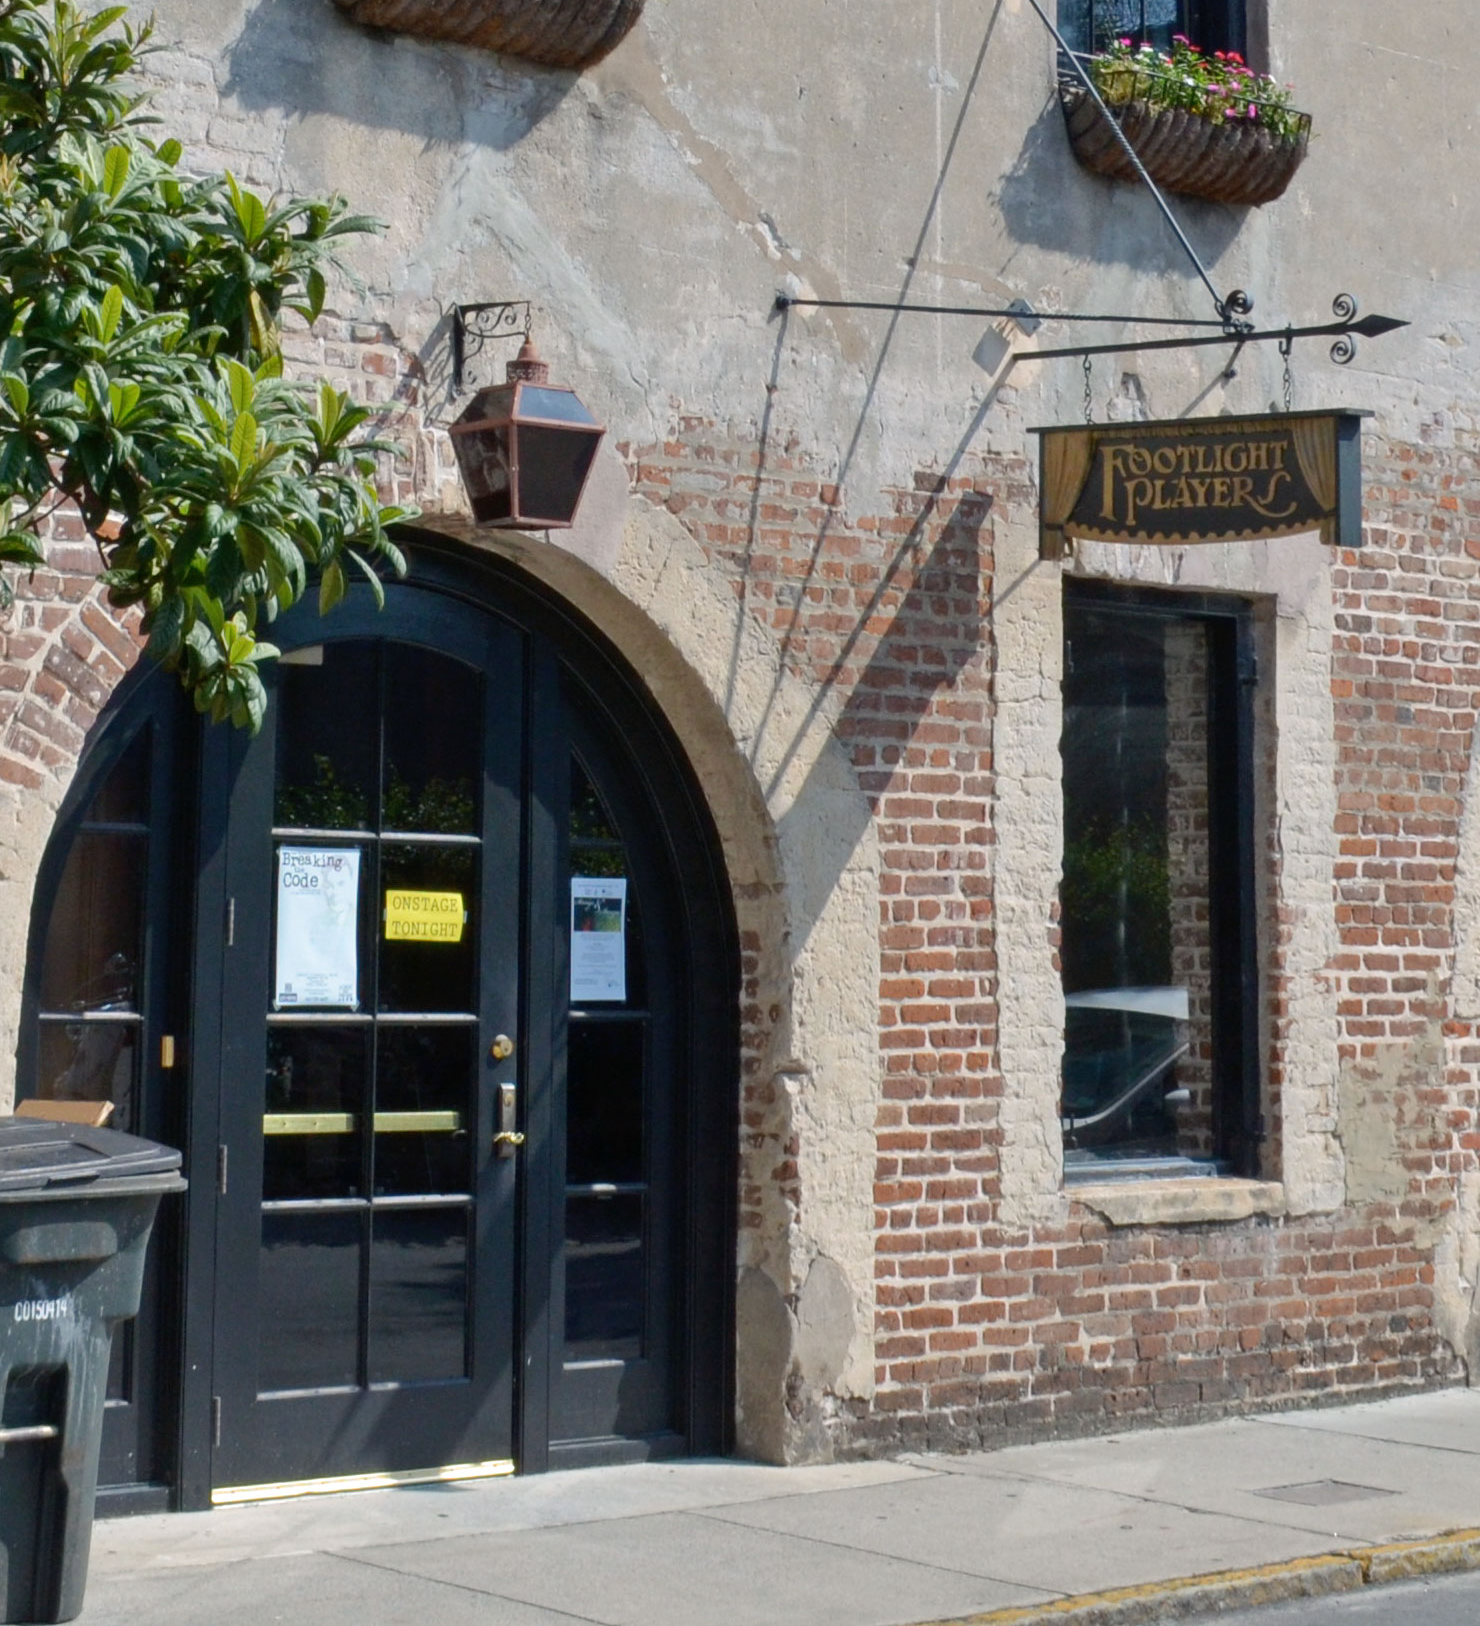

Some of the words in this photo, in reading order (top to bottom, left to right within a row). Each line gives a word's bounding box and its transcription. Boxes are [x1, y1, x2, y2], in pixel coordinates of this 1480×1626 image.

[1124, 471, 1297, 526] PLAYERS
[282, 852, 343, 872] Breaking
[283, 872, 319, 888] Code
[392, 895, 459, 913] ONSTAGE
[391, 920, 458, 937] TONIGHT
